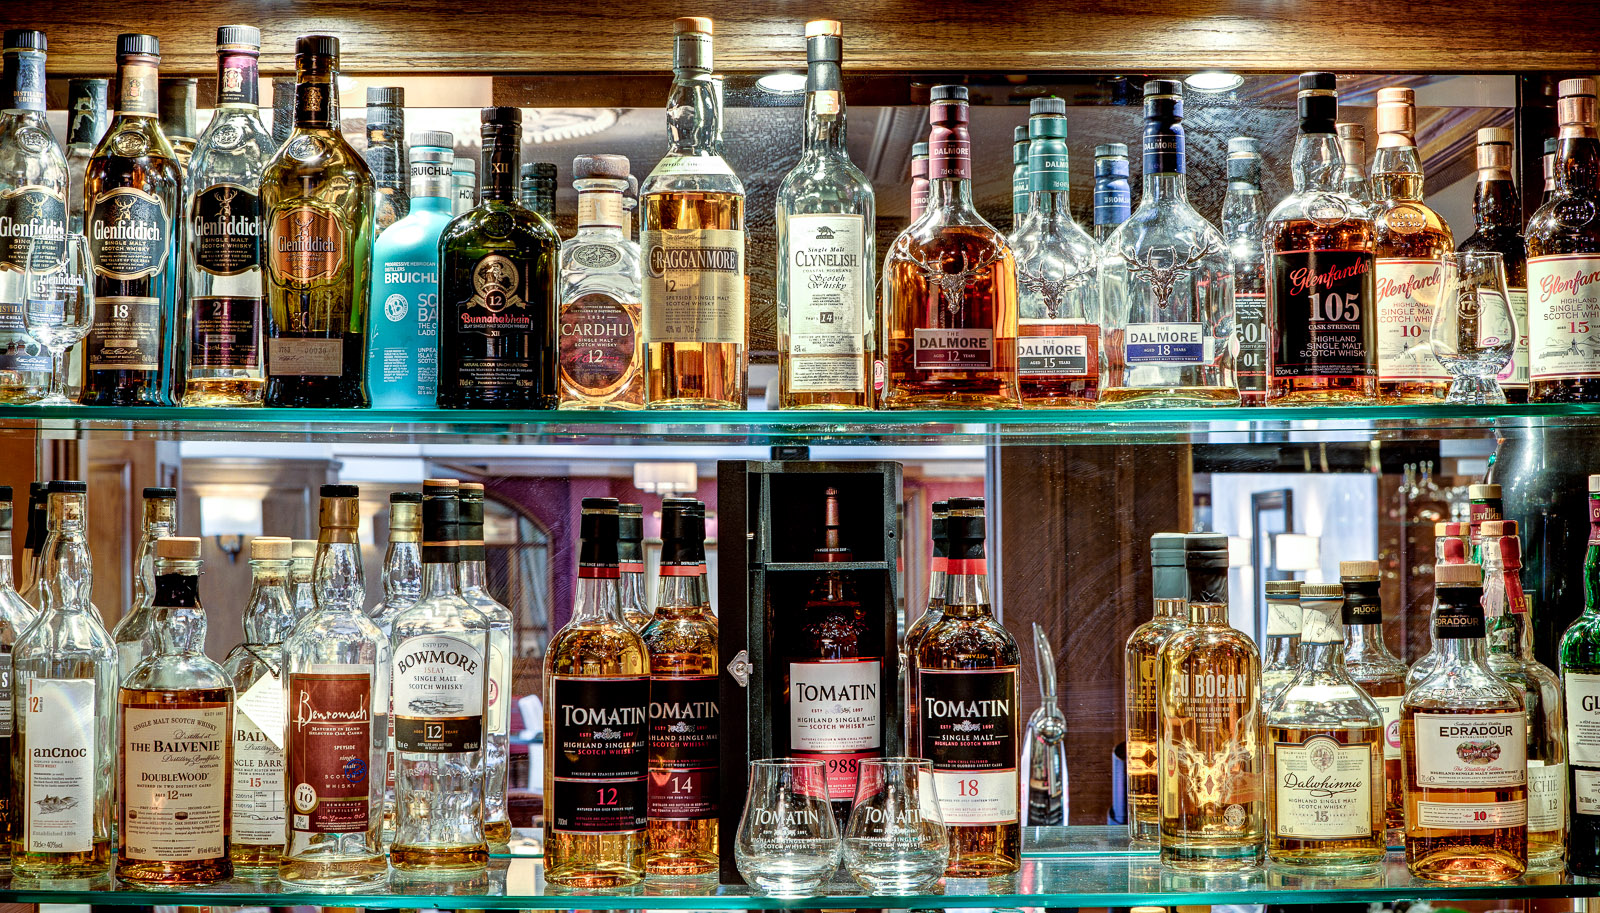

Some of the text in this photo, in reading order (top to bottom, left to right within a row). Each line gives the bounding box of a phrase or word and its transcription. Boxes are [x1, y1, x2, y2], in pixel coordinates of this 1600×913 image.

[1144, 142, 1177, 151] DALMORE
[491, 163, 509, 173] XII
[94, 219, 162, 241] Glenfiddich
[195, 215, 261, 236] Glenfiddich
[277, 236, 336, 252] Glenfiddich
[649, 245, 735, 279] CRAGGANMORE
[795, 251, 857, 267] CLYNELISH
[40, 274, 85, 285] Glenfiddich
[385, 272, 437, 284] BRUICHL
[1290, 257, 1369, 296] Glenfarclas
[32, 281, 46, 293] 15
[666, 280, 677, 292] 12
[489, 296, 502, 306] 12
[114, 305, 128, 318] 18
[213, 301, 228, 316] 21
[1308, 292, 1360, 323] 105
[1550, 304, 1583, 313] SINGLE
[461, 313, 529, 324] Bunnahabhain
[821, 313, 833, 323] 14
[1544, 312, 1579, 321] SCOTCH
[562, 323, 629, 336] CARDHU
[1400, 325, 1422, 337] 10
[1568, 321, 1590, 334] 15
[920, 337, 988, 349] DALMORE
[1130, 332, 1198, 343] DALMORE
[588, 350, 604, 363] 12
[946, 351, 960, 361] 12
[1019, 345, 1081, 356] DALMORE
[1157, 345, 1171, 356] 18
[1300, 350, 1335, 358] SCOTCH
[1043, 358, 1056, 368] 15
[1513, 597, 1525, 608] 12
[398, 650, 478, 675] BOWMORE
[796, 683, 876, 703] TOMATIN
[29, 696, 39, 713] 12
[925, 698, 1010, 719] TOMATIN
[298, 690, 367, 733] Benromach
[562, 705, 646, 727] TOMATIN
[133, 721, 151, 732] SINGLE
[197, 720, 218, 732] WHISKY
[1440, 726, 1513, 737] EDRADOUR
[427, 726, 442, 739] 12
[130, 740, 221, 753] THE BALVENIE
[34, 748, 87, 758] anCnoc
[249, 778, 261, 788] 15
[671, 777, 693, 794] 14
[1284, 772, 1362, 788] Dalwhinnie
[958, 779, 979, 797] 18
[167, 790, 179, 800] 12
[298, 792, 312, 803] 10
[597, 787, 618, 806] 12
[1548, 799, 1558, 810] 12
[754, 807, 819, 825] TOMATIN
[1314, 811, 1329, 822] 15
[1474, 811, 1487, 821] 10
